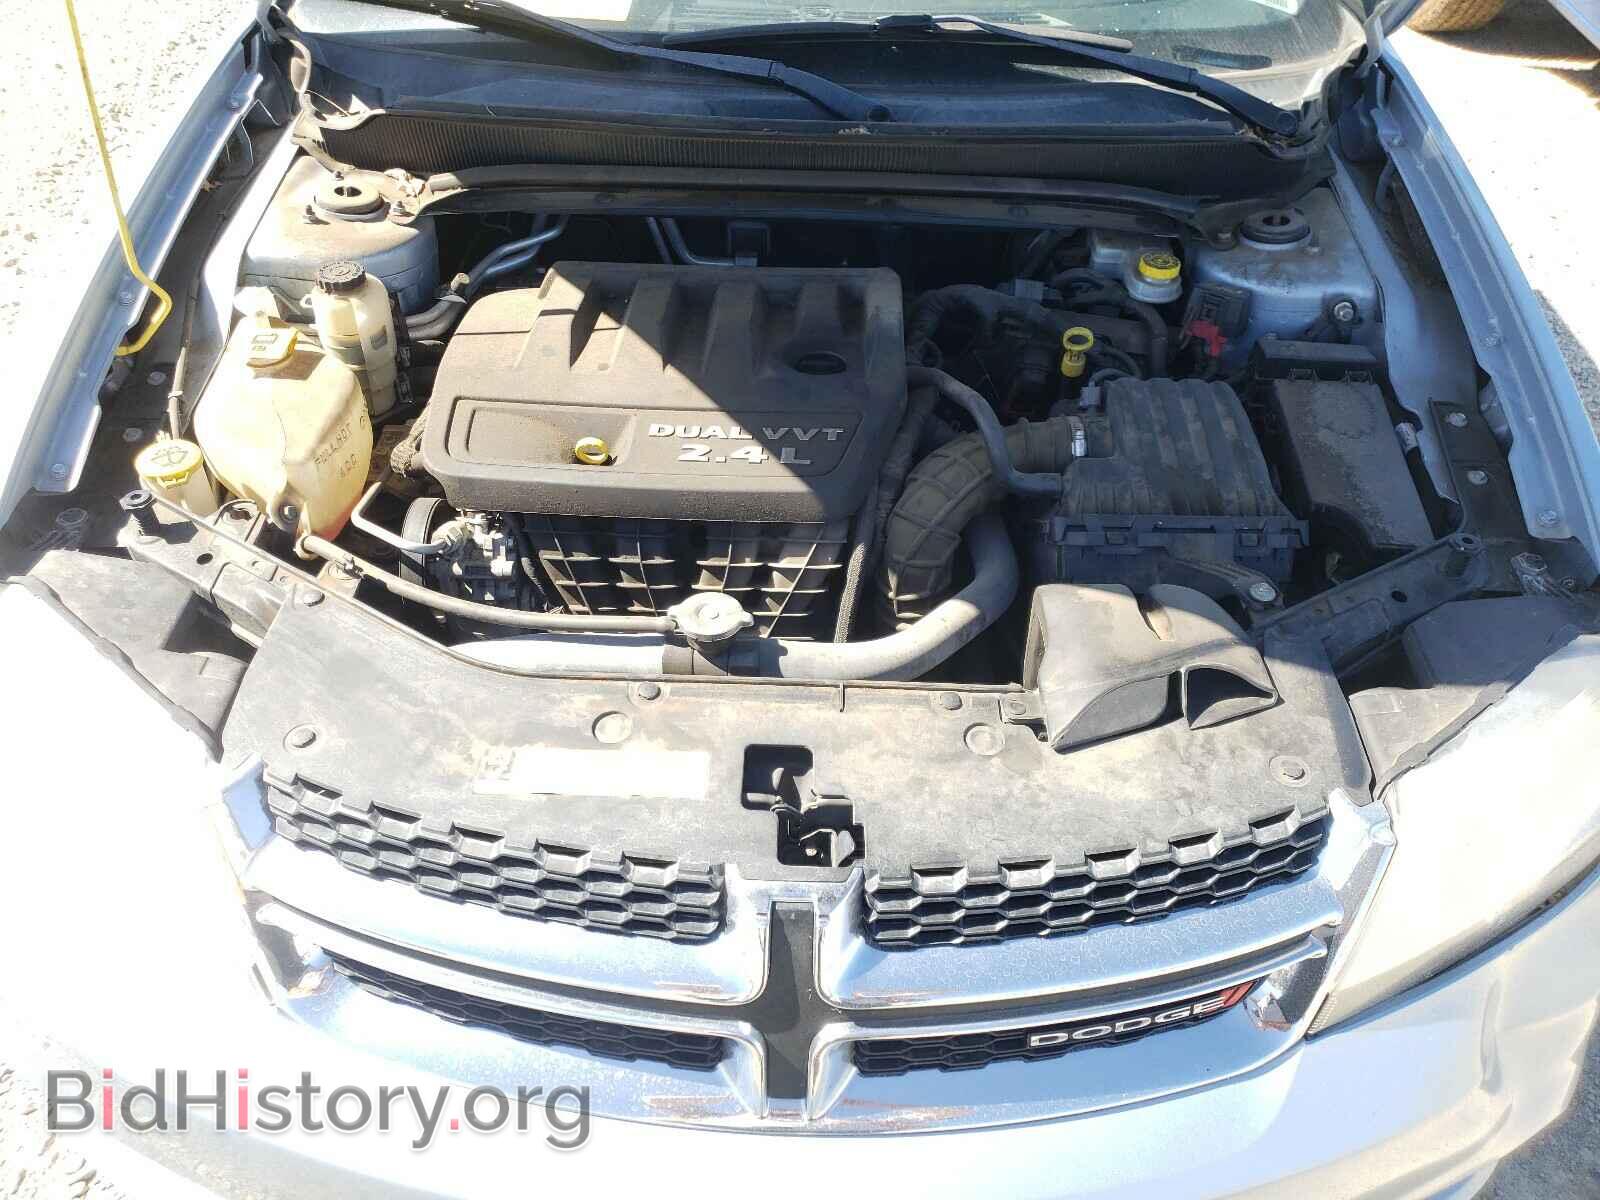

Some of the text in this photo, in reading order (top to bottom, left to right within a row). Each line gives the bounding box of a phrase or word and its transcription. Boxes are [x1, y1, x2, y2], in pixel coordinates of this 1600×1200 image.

[648, 423, 846, 441] DUAL VVT
[1029, 995, 1226, 1048] DODGE
